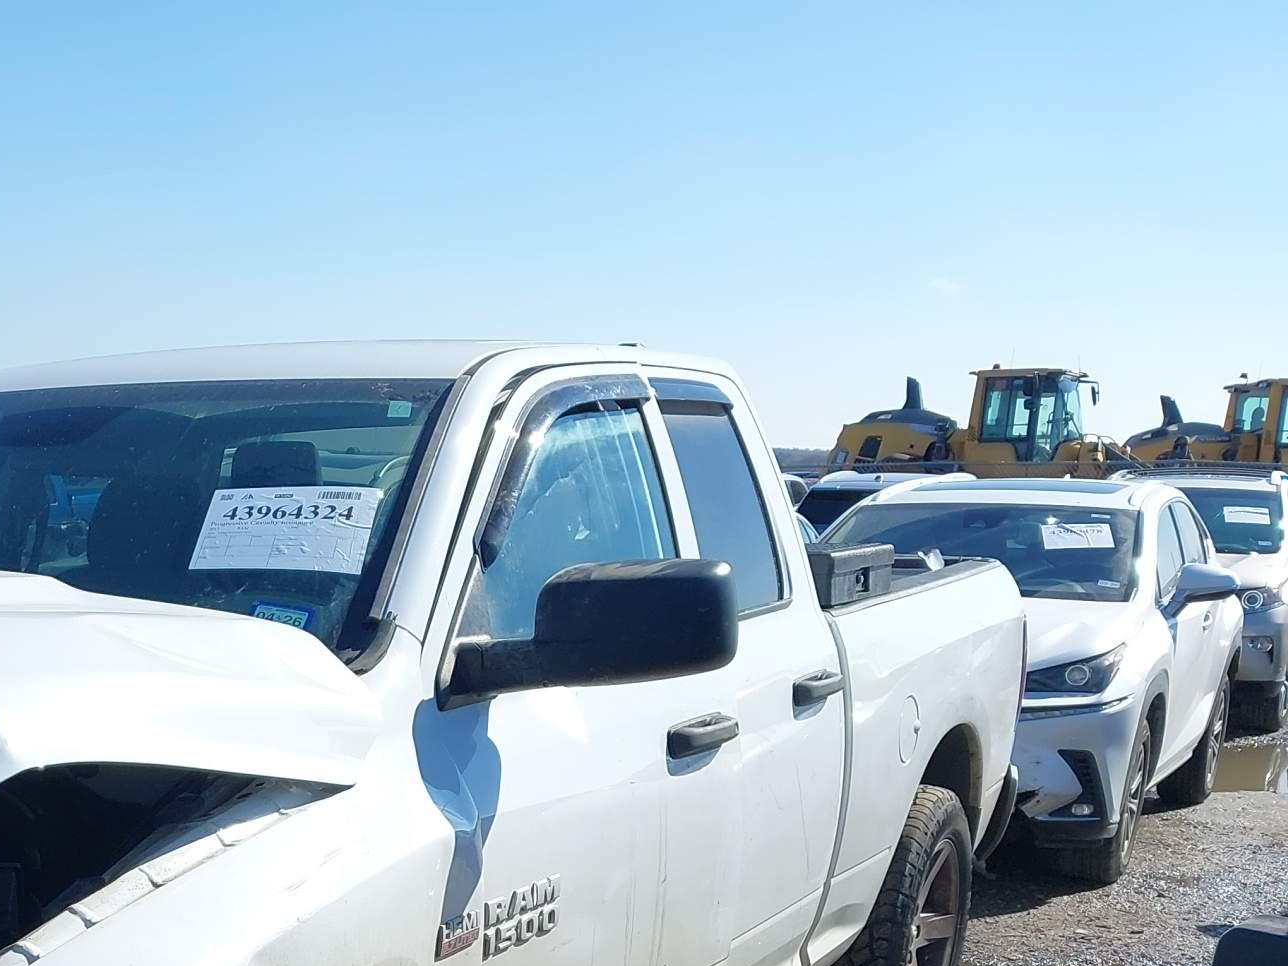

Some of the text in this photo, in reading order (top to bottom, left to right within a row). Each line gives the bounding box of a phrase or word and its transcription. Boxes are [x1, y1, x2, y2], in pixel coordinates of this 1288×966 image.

[223, 504, 354, 521] 43964324
[483, 873, 560, 931] RAM
[482, 904, 560, 961] 1500
